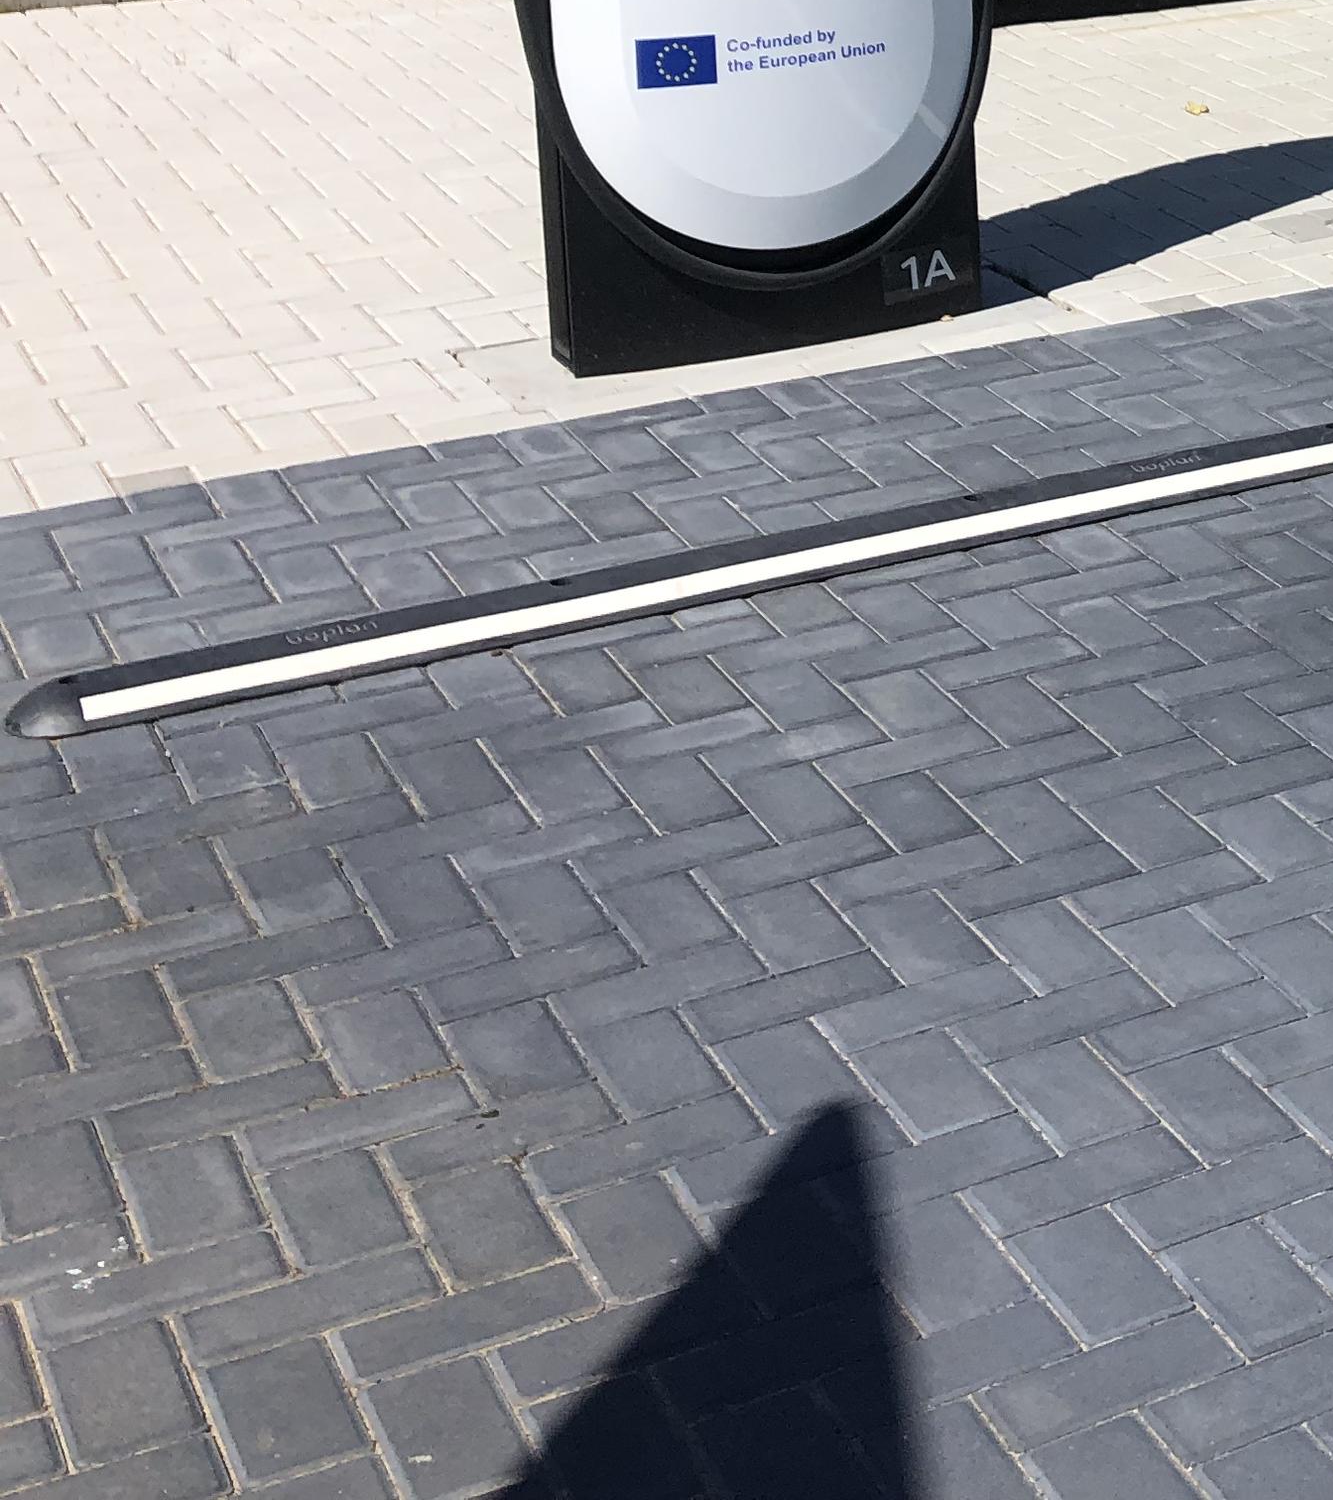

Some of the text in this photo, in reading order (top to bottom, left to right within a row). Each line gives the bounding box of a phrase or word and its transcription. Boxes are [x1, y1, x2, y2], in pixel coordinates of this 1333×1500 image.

[726, 29, 837, 53] Co-funded by
[727, 41, 886, 73] the European Union
[900, 249, 956, 290] 1A
